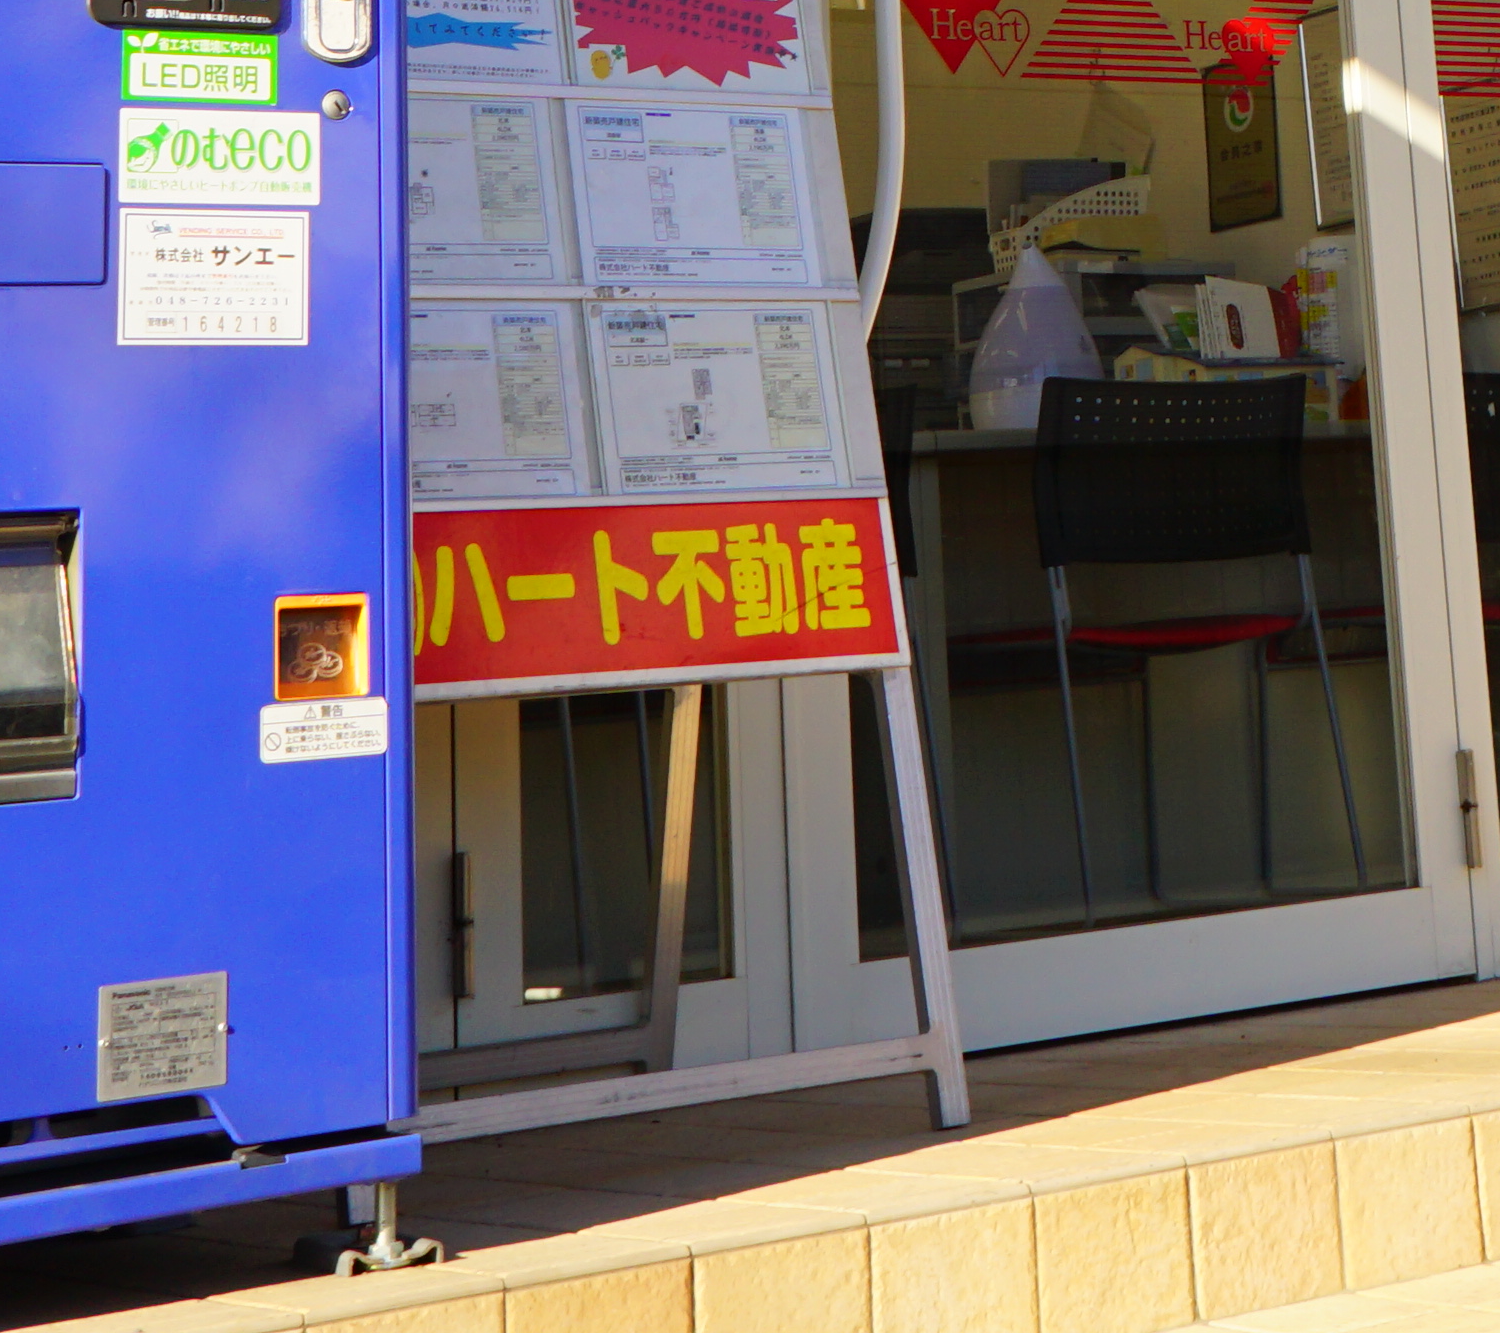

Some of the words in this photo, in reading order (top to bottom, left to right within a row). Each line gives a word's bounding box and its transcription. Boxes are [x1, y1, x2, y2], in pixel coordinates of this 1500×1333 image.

[930, 8, 1023, 42] Heart
[1183, 19, 1268, 54] Heart
[158, 37, 271, 55] 省エネで環境にやさしい
[141, 61, 259, 94] LED照明
[171, 127, 312, 172] のむeco
[155, 248, 205, 263] 株式会社
[211, 245, 296, 266] サンエー
[429, 518, 872, 646] ハート不動産
